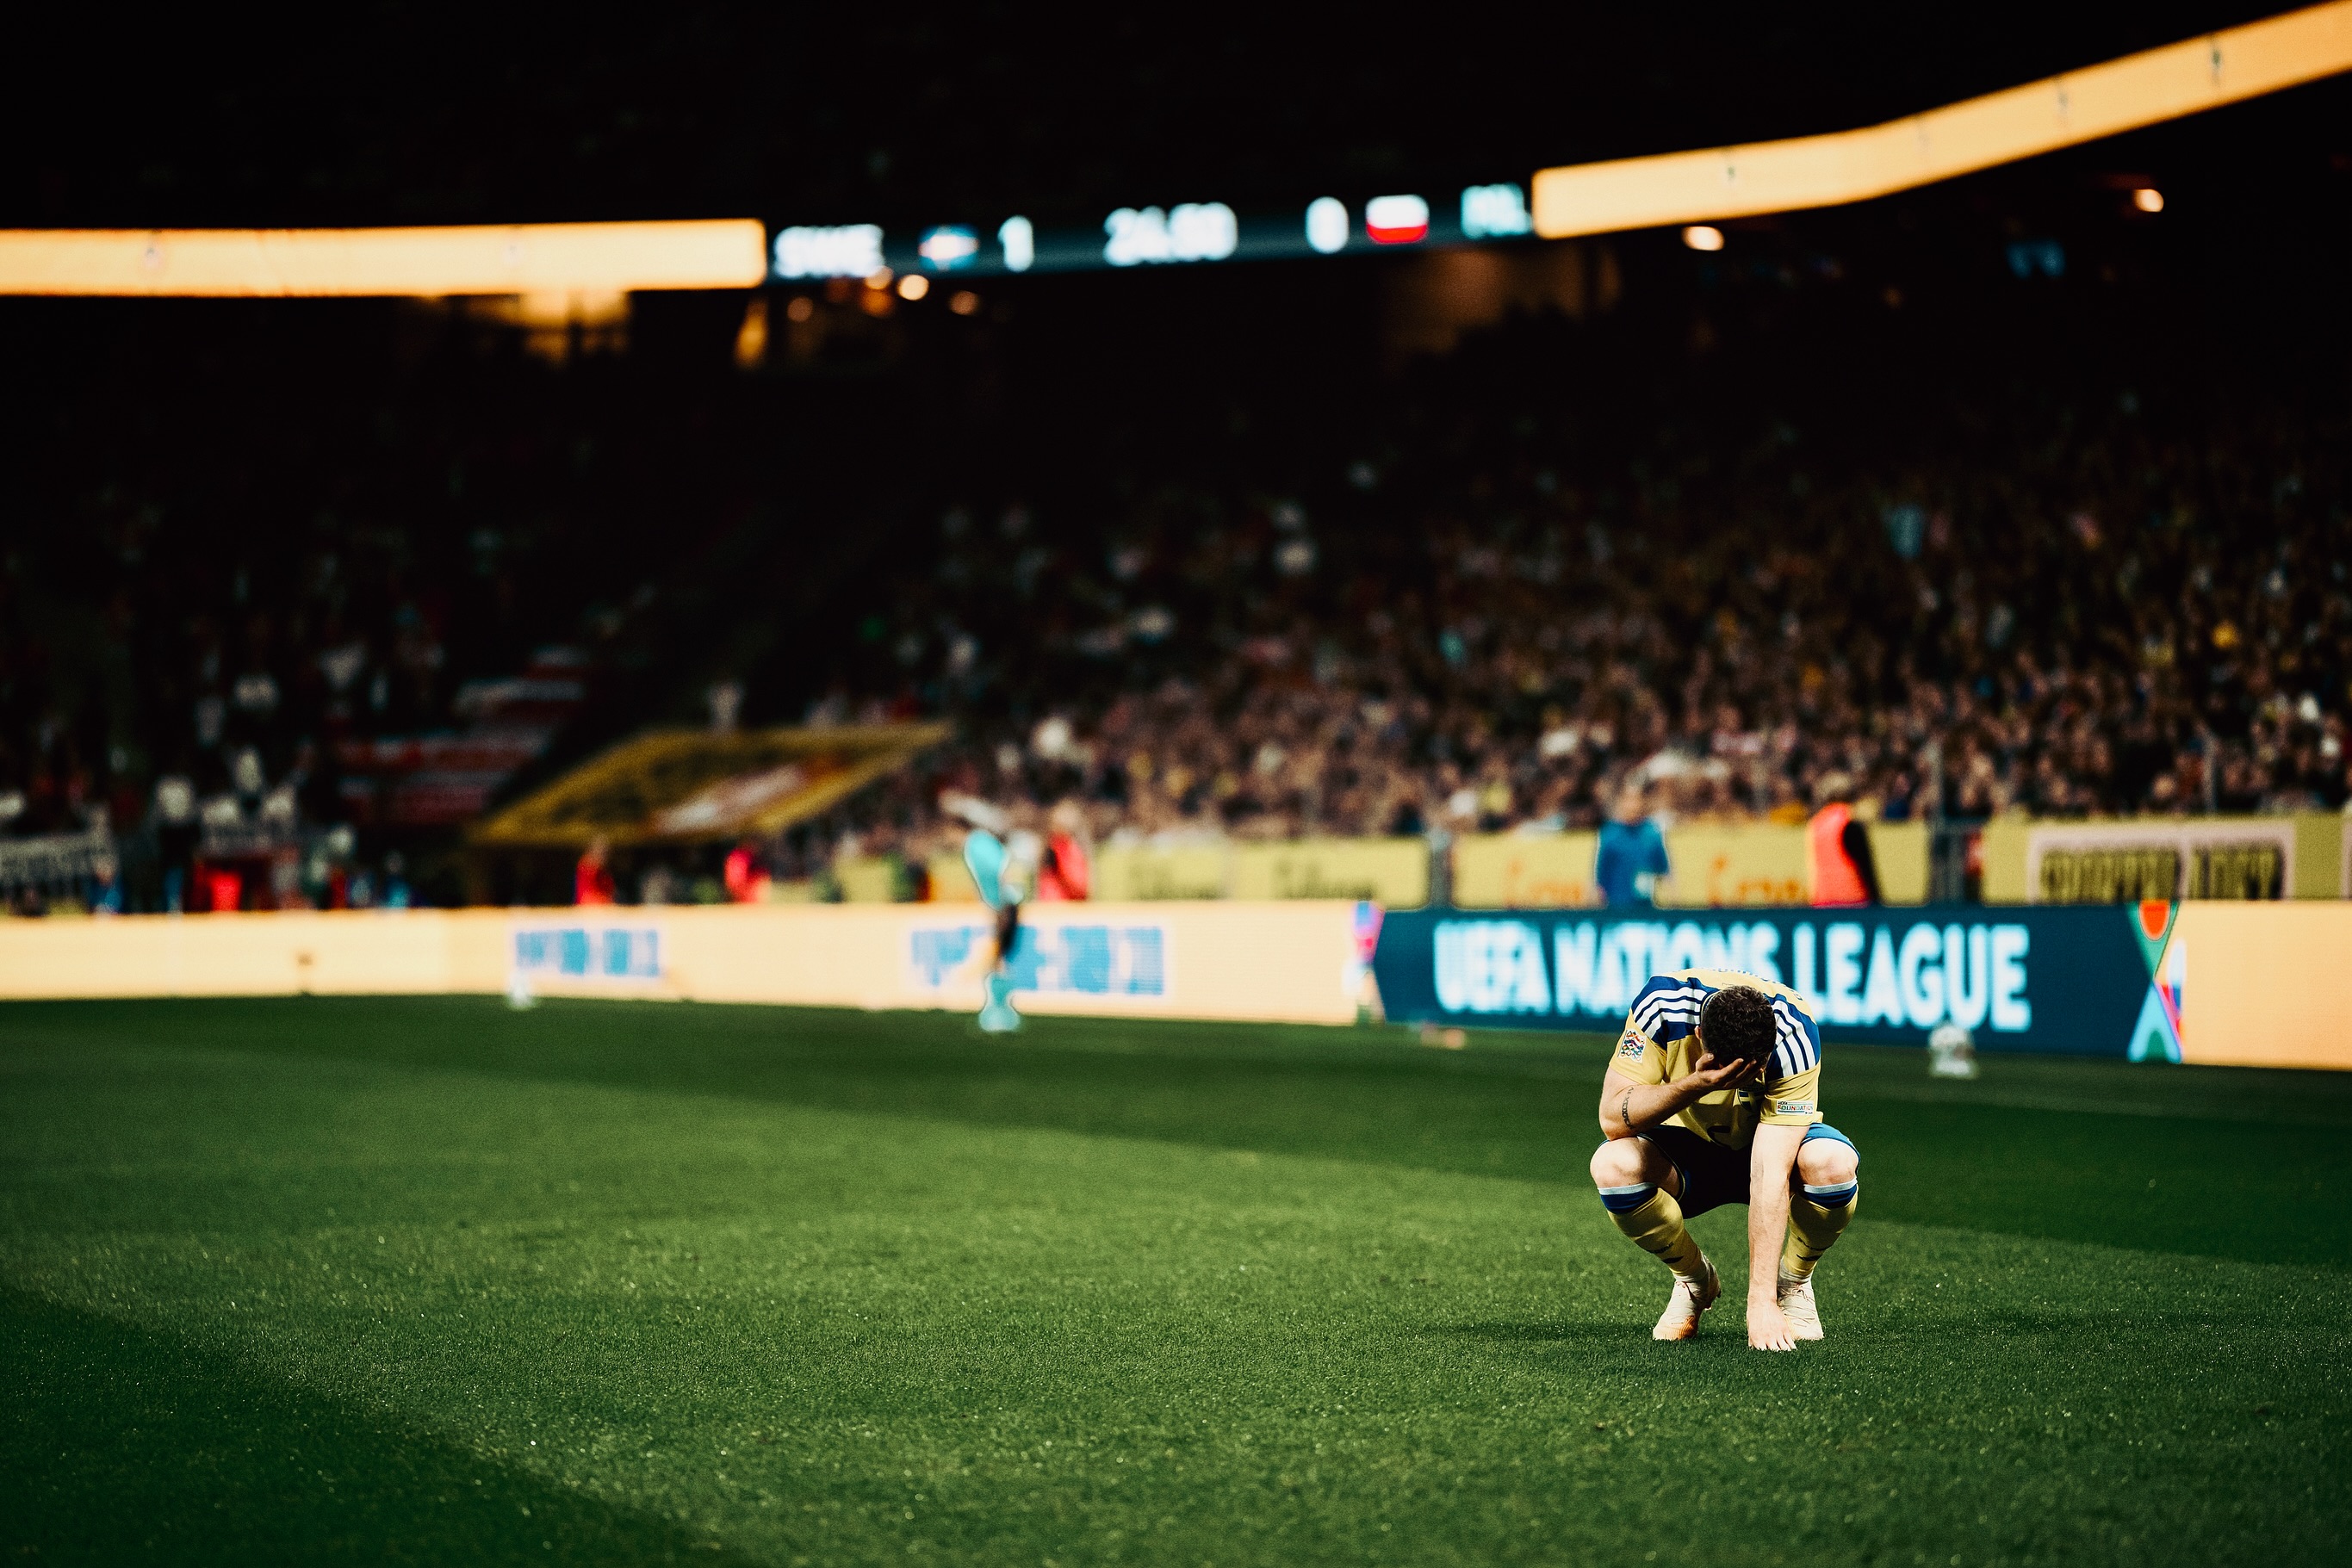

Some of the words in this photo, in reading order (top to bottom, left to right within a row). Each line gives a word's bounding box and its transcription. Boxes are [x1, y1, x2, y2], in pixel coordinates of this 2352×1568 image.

[1433, 920, 1550, 1015] UEFA
[1554, 921, 1782, 1016] NATIONS
[1793, 922, 2031, 1032] LEAGUE
